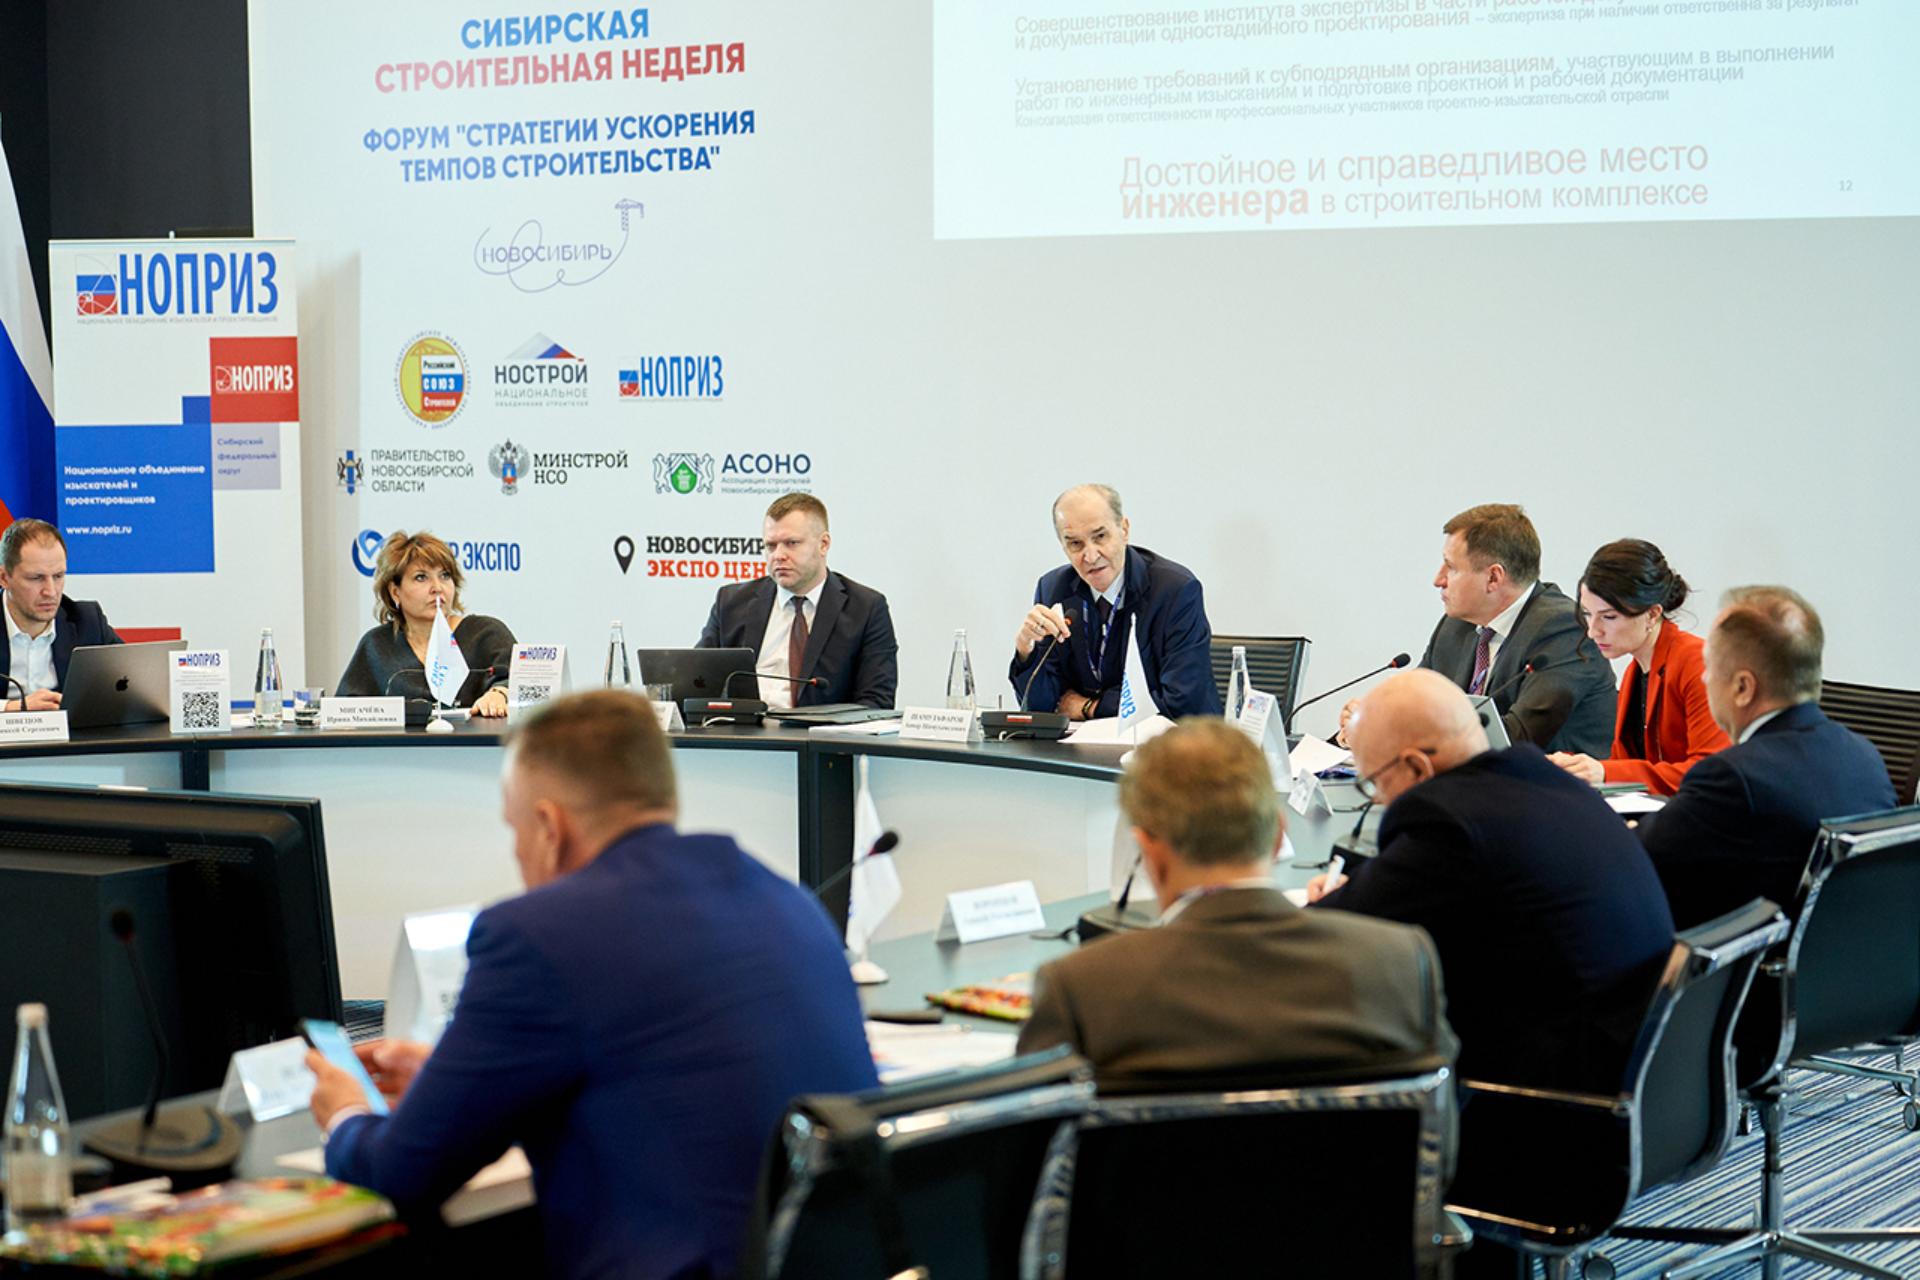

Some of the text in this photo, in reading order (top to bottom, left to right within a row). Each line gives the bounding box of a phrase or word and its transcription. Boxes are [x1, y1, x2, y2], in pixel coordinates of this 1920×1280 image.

[1015, 10, 1199, 35] Совершенствование
[1204, 4, 1295, 23] института
[1301, 0, 1409, 20] экспертизы
[1416, 0, 1425, 10] в
[1015, 36, 1025, 49] и
[1030, 29, 1155, 51] документации
[1161, 18, 1308, 43] одностадийного
[1315, 11, 1470, 36] проектирования
[1487, 8, 1566, 25] экспертиза
[1569, 7, 1595, 22] при
[1599, 4, 1659, 18] наличии
[1664, 1, 1761, 16] ответственна
[461, 8, 649, 49] СИБИРСКАЯ
[374, 42, 745, 93] СТРОИТЕЛЬНАЯ НЕДЕЛЯ
[1015, 44, 1835, 96] Установление требований к субподрядным организациям, участвующим в выполнении
[1015, 64, 1745, 113] работ по инженерным изысканиям и подготовке проектной и рабочей документации
[1215, 102, 1344, 120] профессиональных
[1348, 97, 1424, 116] участников
[363, 110, 755, 152] ФОРУМ "СТРАТЕГИИ УСКОРЕНИЯ
[400, 146, 721, 182] ТЕМПОВ СТРОИТЕЛЬСТВА"
[1120, 145, 1709, 194] Достойное и справедливое место
[1839, 179, 1853, 192] 12
[1122, 183, 1709, 224] инженера в строительном комплексе
[482, 244, 612, 263] НОВОСИБИРЬ
[119, 252, 278, 315] НОПРИЗ
[231, 365, 294, 392] НОПРИЗ
[423, 377, 455, 391] СОЮЗ
[640, 355, 724, 397] НОПРИЗ
[494, 388, 589, 399] НАЦИОНАЛЬНОЕ
[217, 437, 264, 446] Сибирский
[371, 449, 465, 462] ПРАВИТЕЛЬСТВО
[533, 449, 628, 468] МИНСТРОЙ
[721, 453, 811, 474] АСОНО
[64, 464, 205, 476] Национальное объединение
[371, 463, 474, 478] НОВОСИБИРСКОЙ
[534, 469, 568, 485] НСО
[64, 479, 138, 490] изыскателей и
[371, 480, 425, 492] ОБЛАСТИ
[65, 495, 156, 507] проектировщиков
[66, 524, 132, 536] www.nopriz.ru
[646, 536, 765, 555] НОВОСИБИР
[463, 542, 521, 571] ЭКСПО
[647, 560, 767, 582] ЭКСПО ЦЕН
[186, 652, 221, 666] НОПРИЗ
